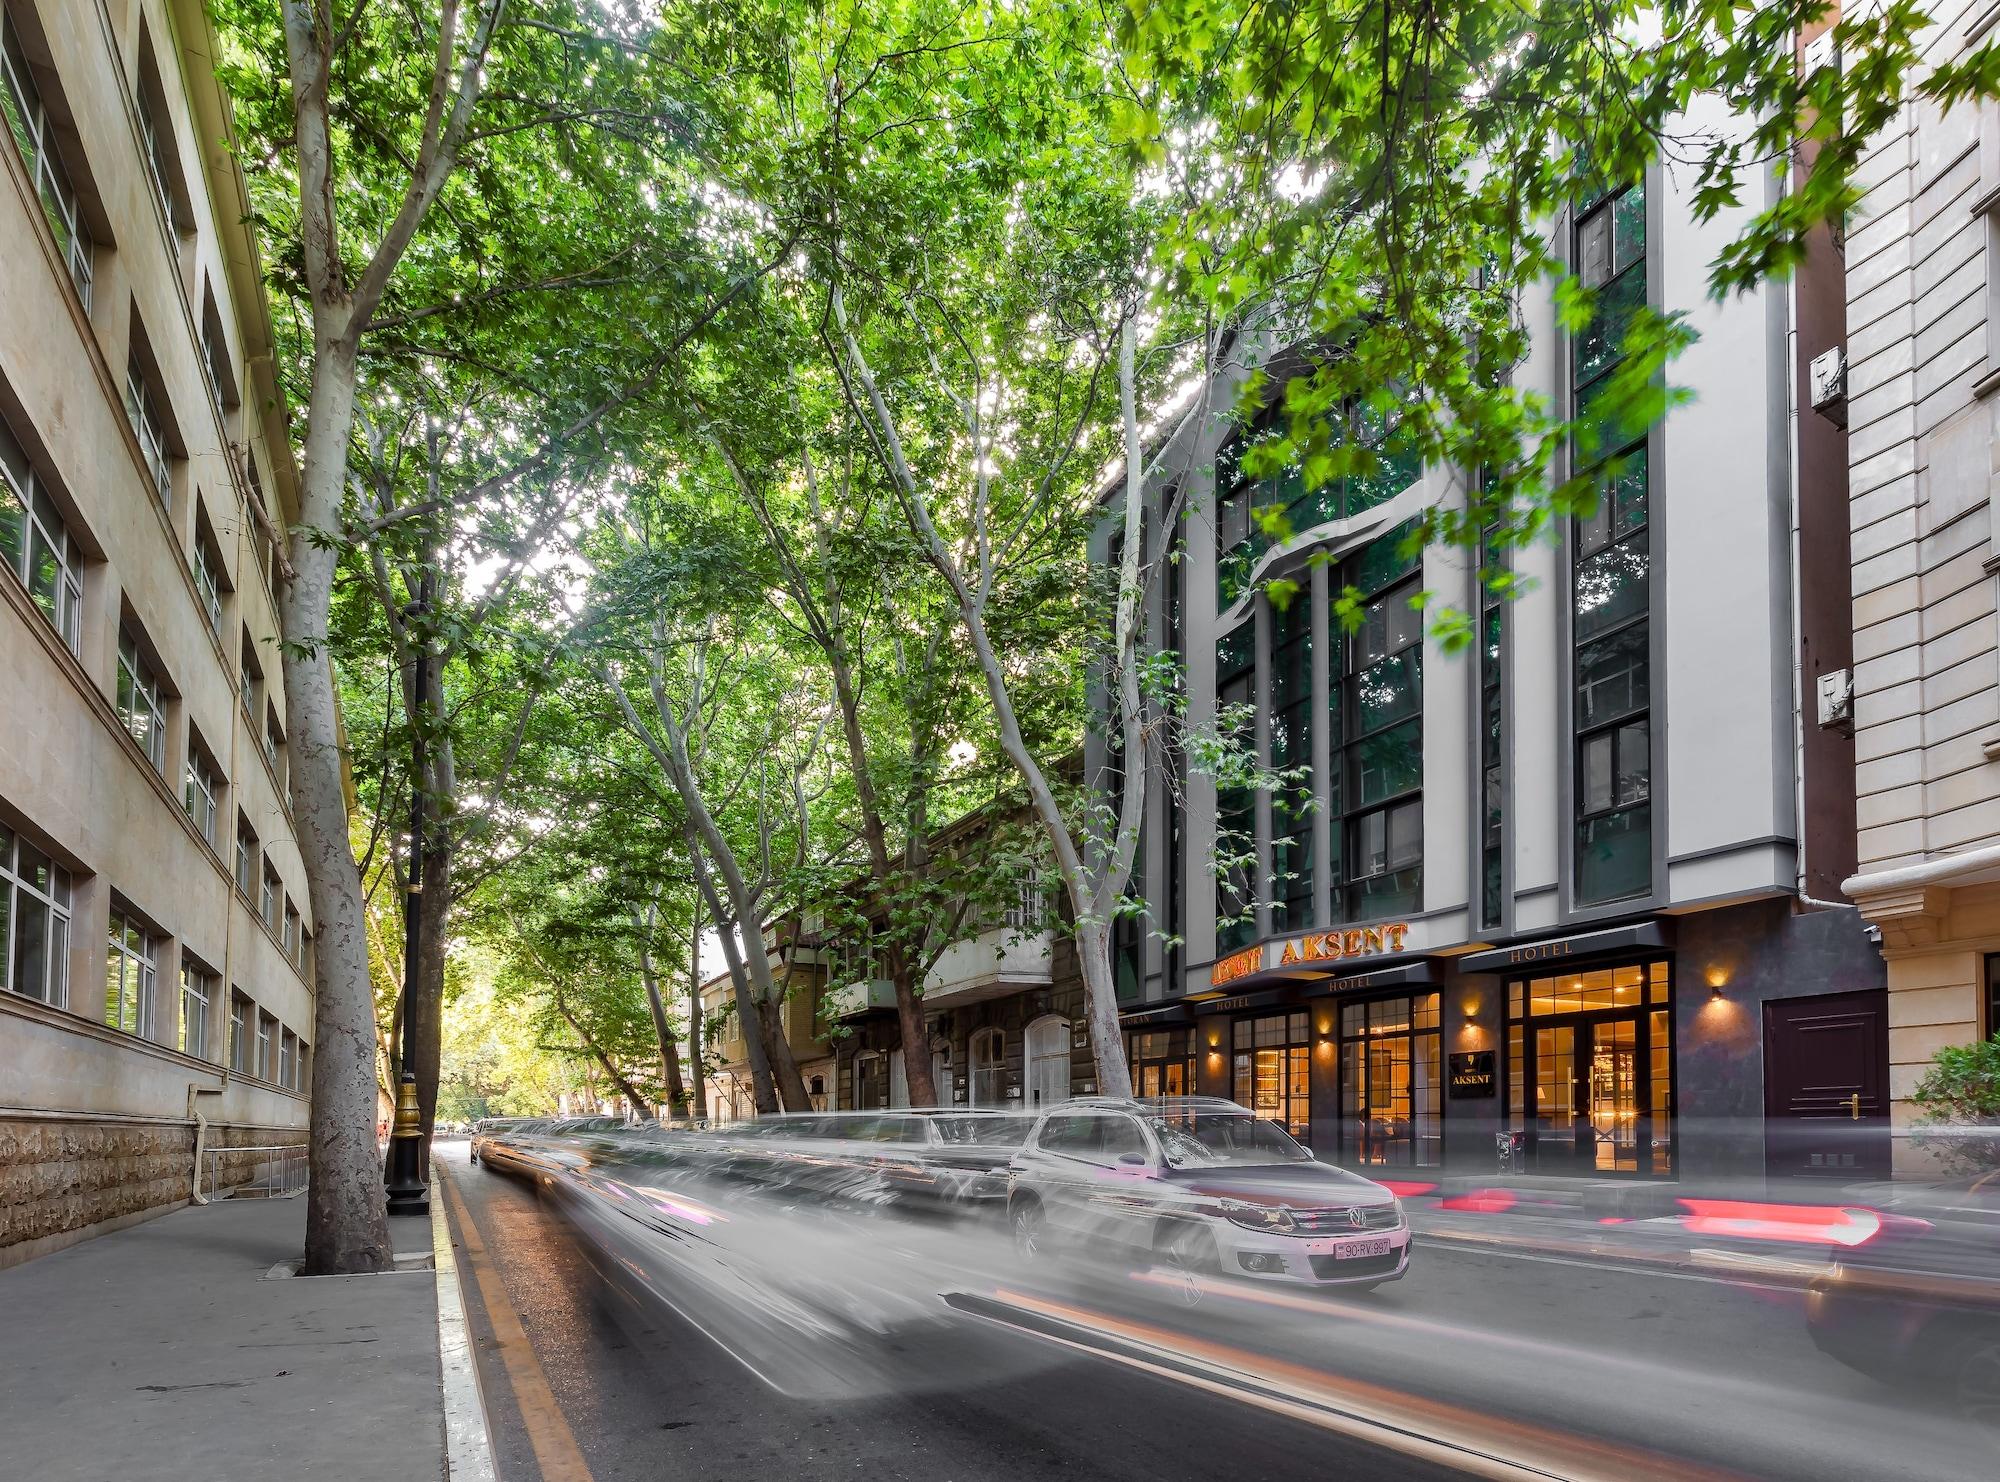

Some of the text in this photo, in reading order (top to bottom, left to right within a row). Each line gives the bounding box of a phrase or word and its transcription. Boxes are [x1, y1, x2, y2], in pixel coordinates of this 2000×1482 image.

[1280, 922, 1409, 966] AKSENT
[1510, 941, 1574, 963] HOTEL
[1328, 976, 1371, 992] HOTEL
[1216, 996, 1250, 1012] HOTEL
[1453, 1074, 1491, 1085] AKSENT
[1345, 1241, 1389, 1257] 90-RV-997
